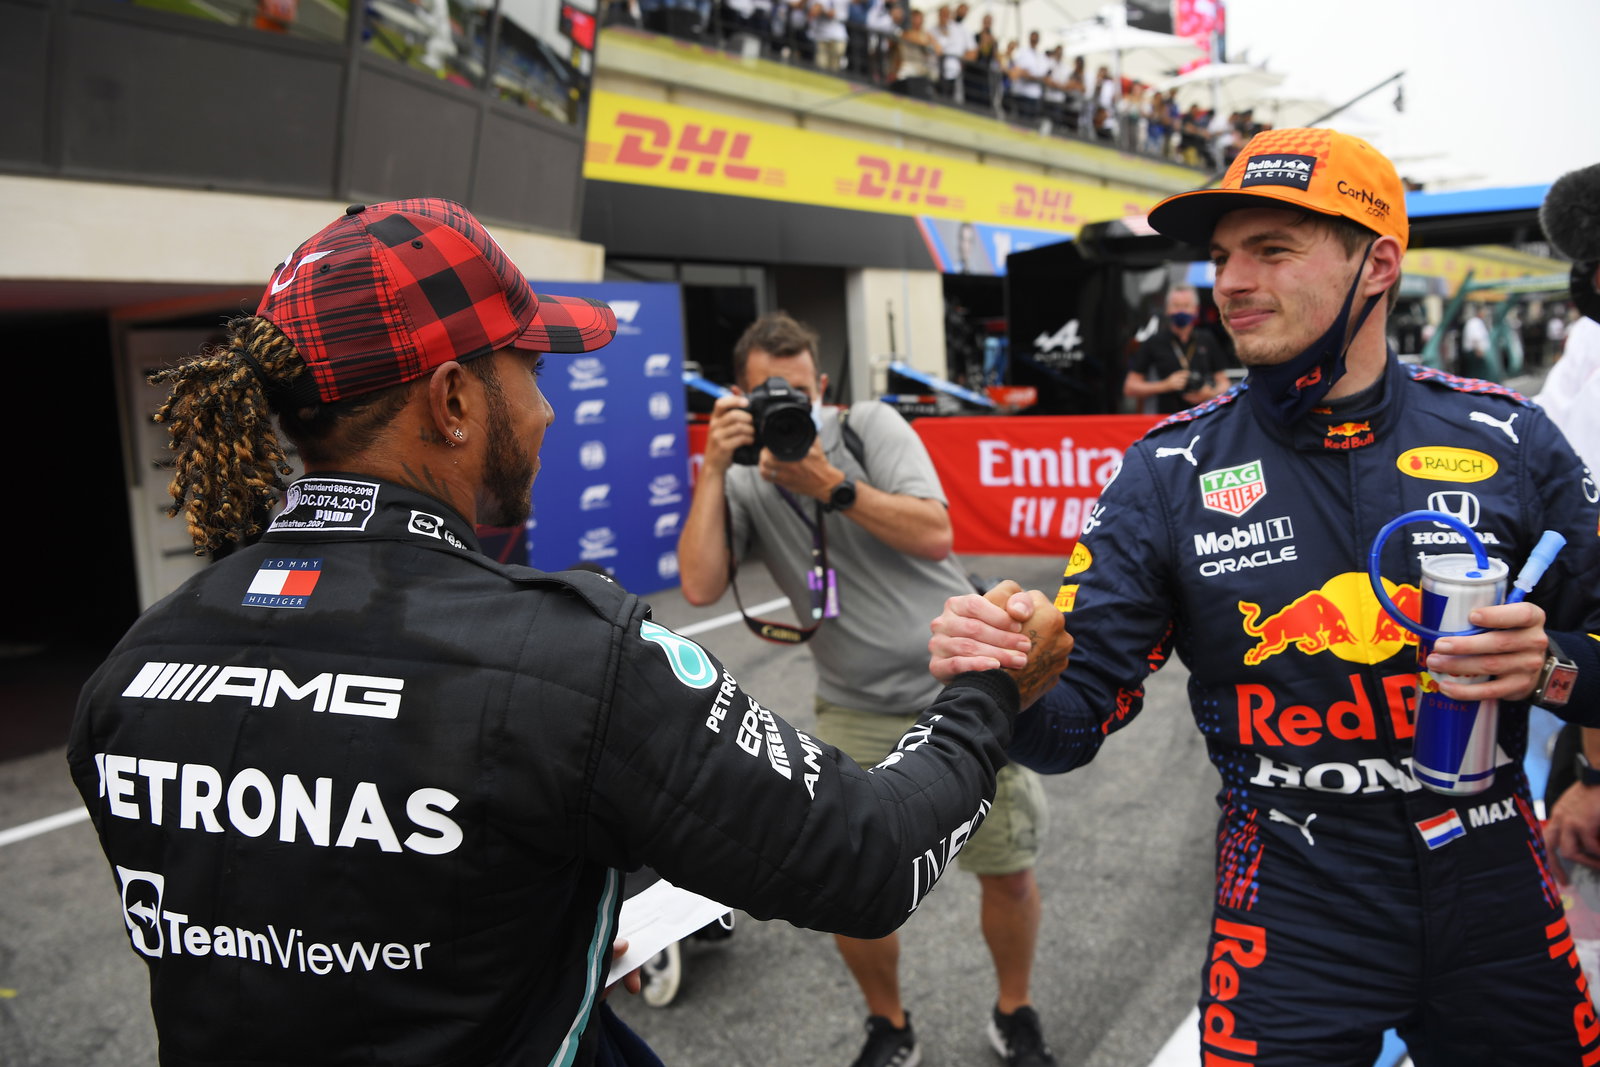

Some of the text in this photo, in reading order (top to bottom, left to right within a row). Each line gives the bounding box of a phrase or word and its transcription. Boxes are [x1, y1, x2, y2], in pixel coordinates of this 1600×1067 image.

[615, 111, 760, 182] DHL
[856, 155, 948, 207] DHL
[1244, 171, 1308, 182] RACING
[1013, 183, 1076, 225] DHL
[1337, 180, 1390, 216] CarNext
[1324, 433, 1374, 449] Red Bull
[1205, 465, 1256, 490] TAG
[1425, 456, 1483, 473] RAUCH
[304, 483, 373, 496] Standard 8856-2018
[1207, 483, 1262, 512] HEUER
[1010, 496, 1057, 536] FLY
[1193, 522, 1266, 555] Mobil
[267, 560, 318, 568] TOMMY
[1199, 545, 1298, 577] ORACLE
[248, 596, 303, 605] HILFIGER
[197, 665, 405, 720] AMG
[1235, 674, 1377, 747] Red
[1468, 797, 1518, 828] MAX
[163, 910, 431, 975] TeamViewer
[1203, 918, 1267, 1056] Red
